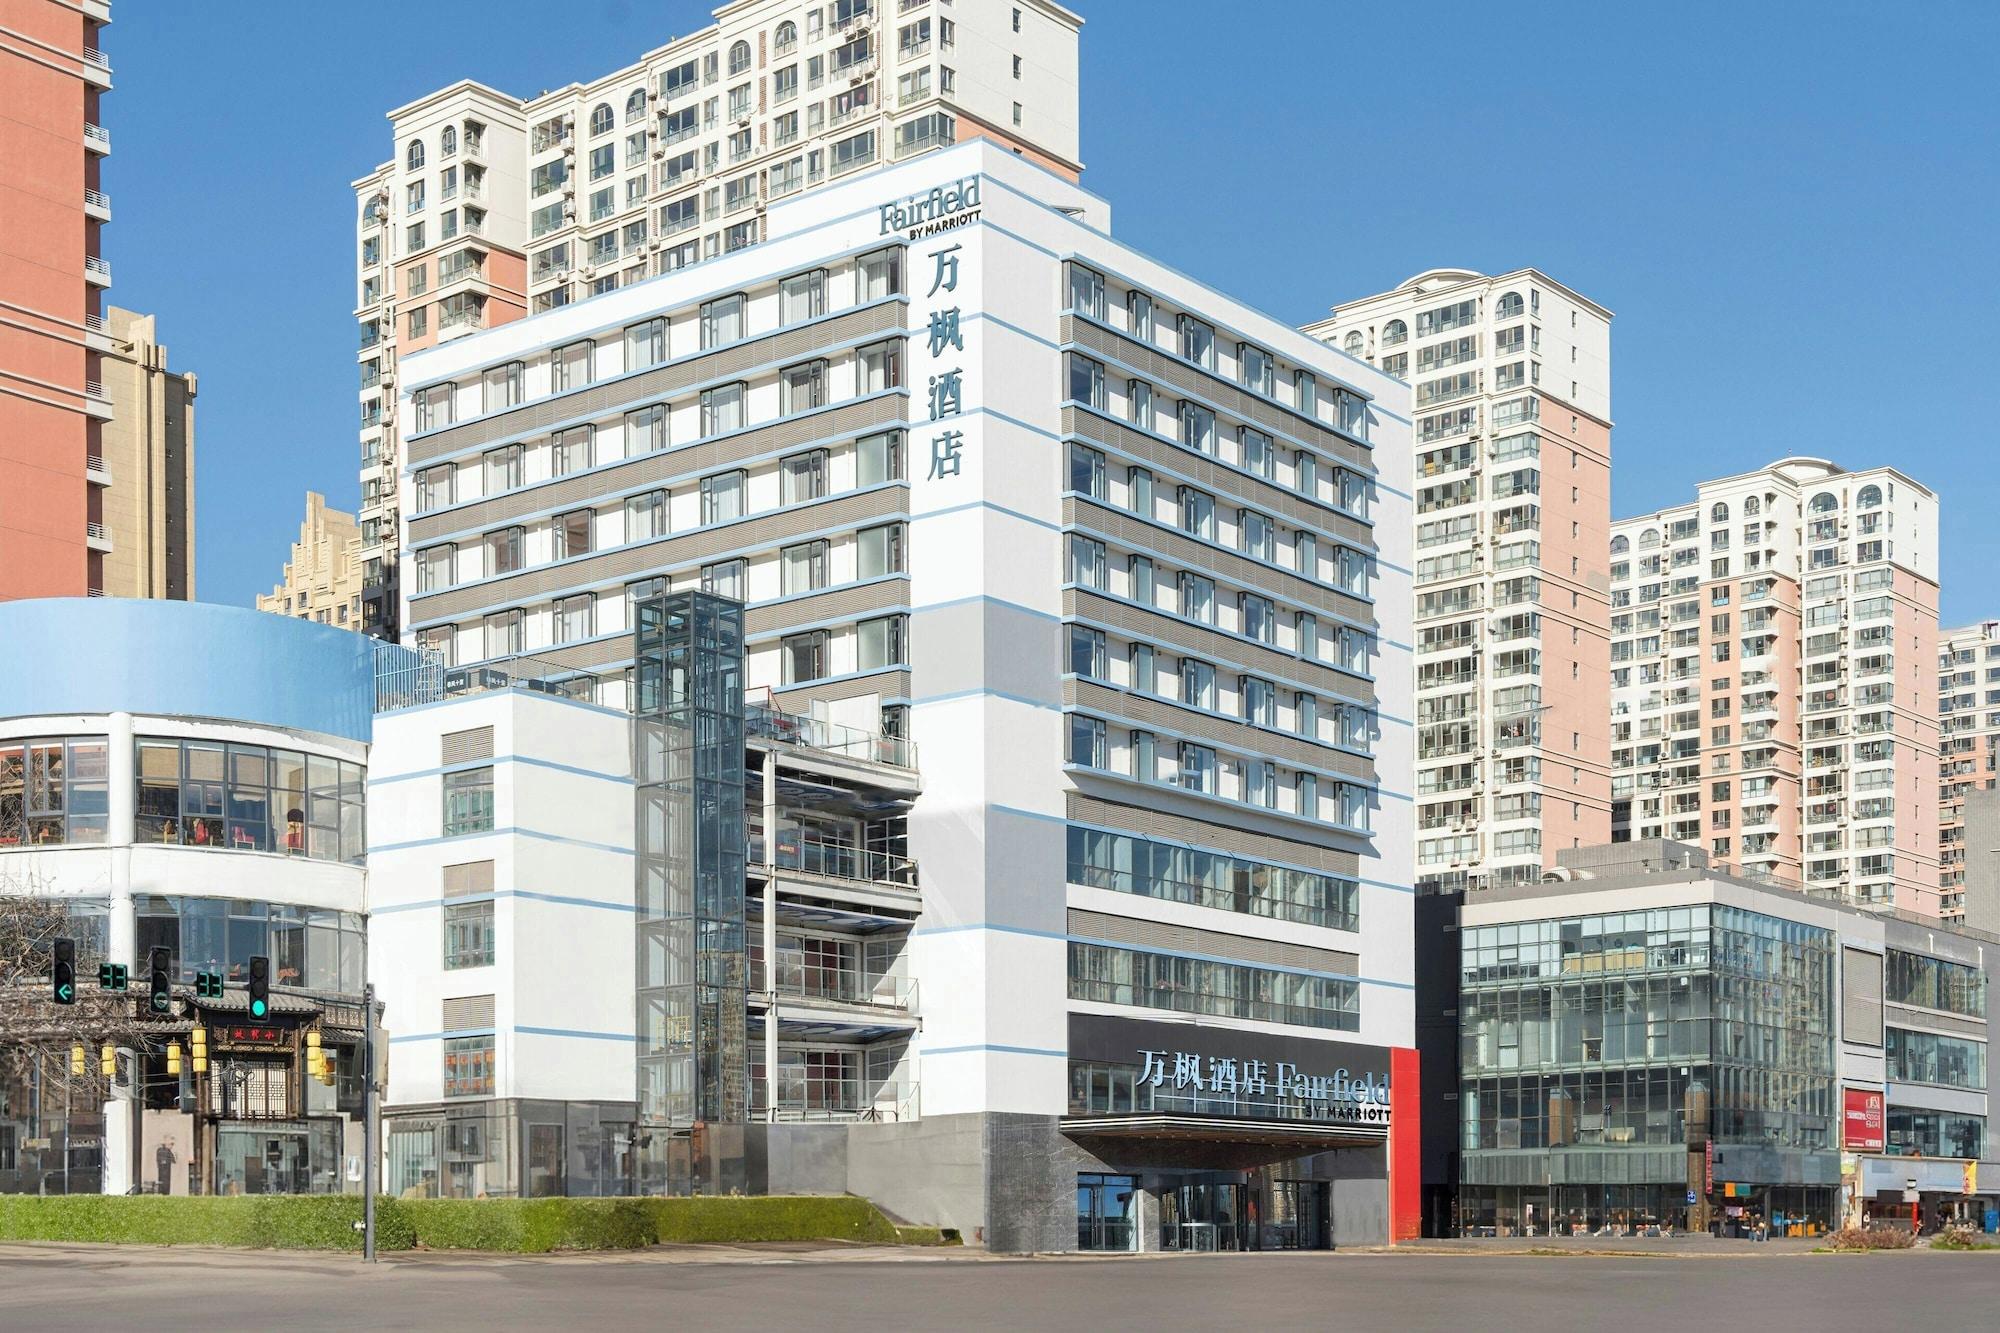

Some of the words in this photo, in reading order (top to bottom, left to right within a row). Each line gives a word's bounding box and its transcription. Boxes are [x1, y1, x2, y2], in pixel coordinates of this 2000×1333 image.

[879, 174, 981, 236] Fairfield
[909, 227, 924, 241] BY
[925, 209, 982, 237] MARRIOTT
[926, 242, 965, 482] 万枫酒店
[101, 964, 127, 990] 33
[198, 972, 223, 998] 33
[1136, 1049, 1267, 1096] 万枫酒店
[1275, 1062, 1391, 1106] Fairfield
[1305, 1104, 1321, 1118] BY
[1326, 1106, 1391, 1122] MARRIOTT
